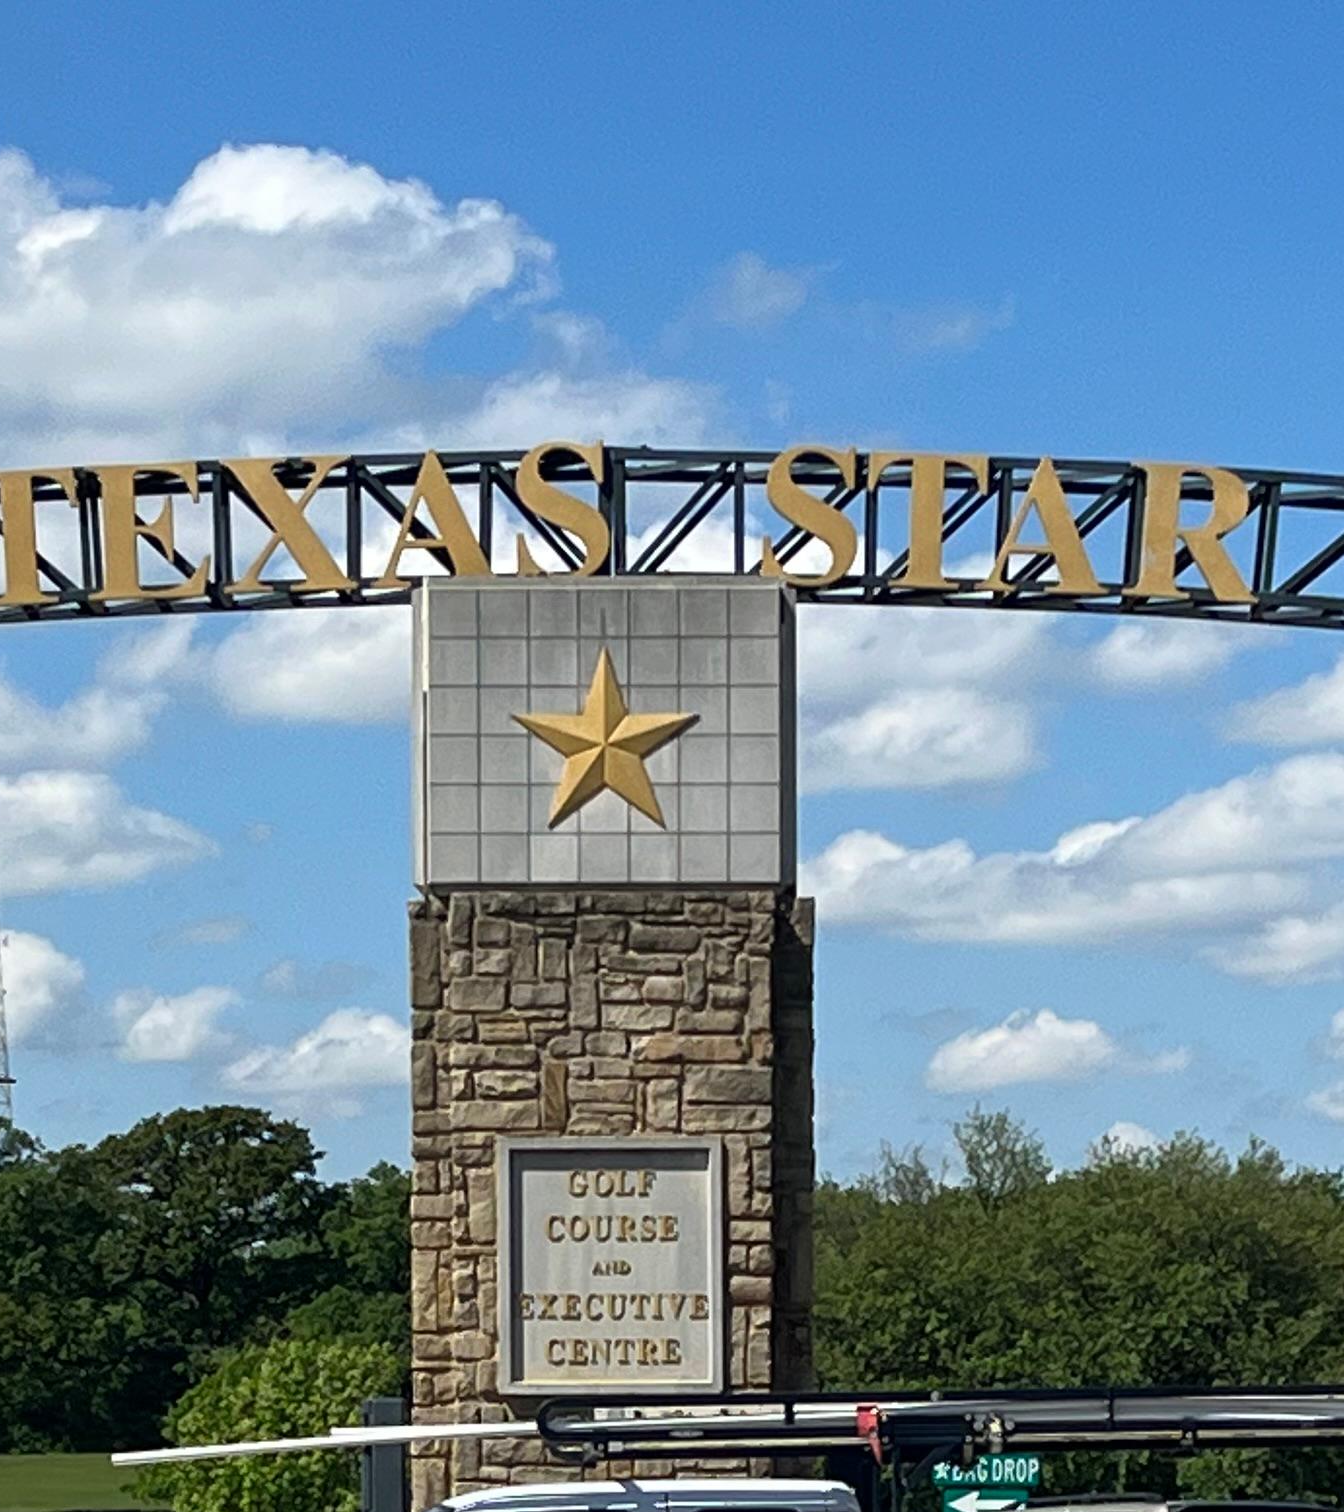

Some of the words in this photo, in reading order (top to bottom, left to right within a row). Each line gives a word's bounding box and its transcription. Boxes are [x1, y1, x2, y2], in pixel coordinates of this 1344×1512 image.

[762, 446, 1258, 605] STAR
[567, 1169, 658, 1198] GOLF
[546, 1215, 680, 1243] COURSE
[591, 1260, 633, 1276] AND
[519, 1292, 710, 1321] EXECUTIVE
[544, 1337, 683, 1366] CENTRE
[992, 1458, 1039, 1482] DROP
